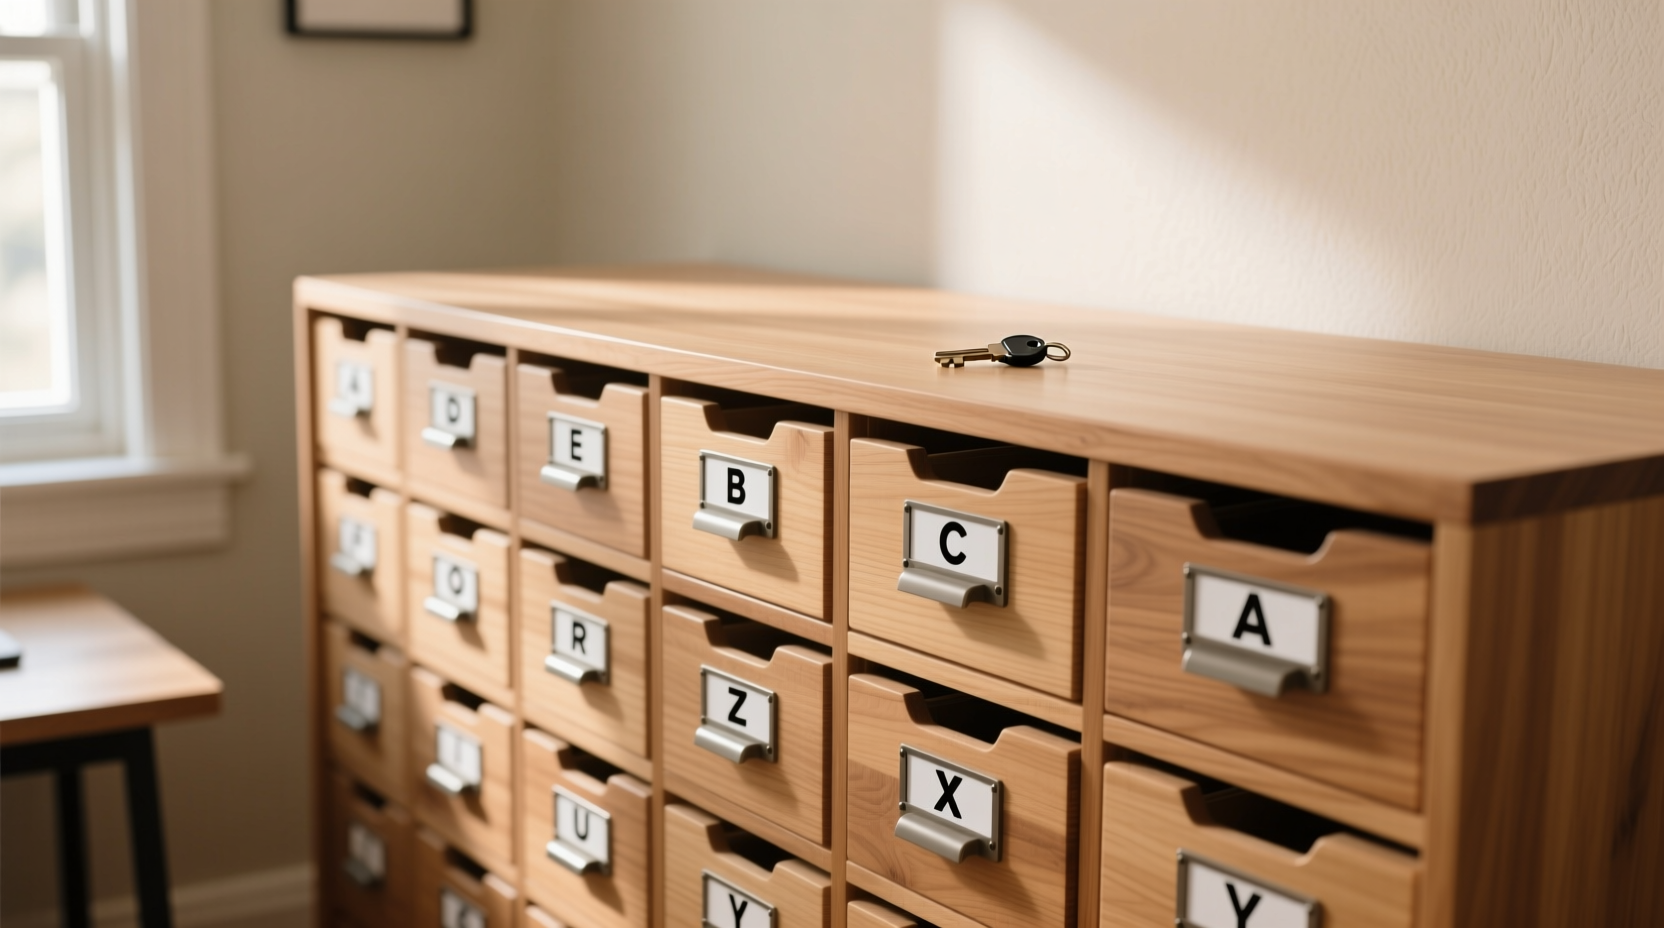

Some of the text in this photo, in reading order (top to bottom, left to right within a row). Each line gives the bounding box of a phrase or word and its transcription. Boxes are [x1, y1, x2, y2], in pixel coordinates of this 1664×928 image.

[447, 397, 460, 423] D
[570, 429, 583, 462] E
[727, 467, 746, 505] B
[939, 521, 968, 566] C
[573, 621, 586, 654] R
[1232, 593, 1272, 647] A
[727, 687, 747, 727] Z
[933, 769, 962, 820] X
[575, 808, 589, 841] U
[729, 893, 748, 928] Y
[1225, 882, 1262, 928] Y
